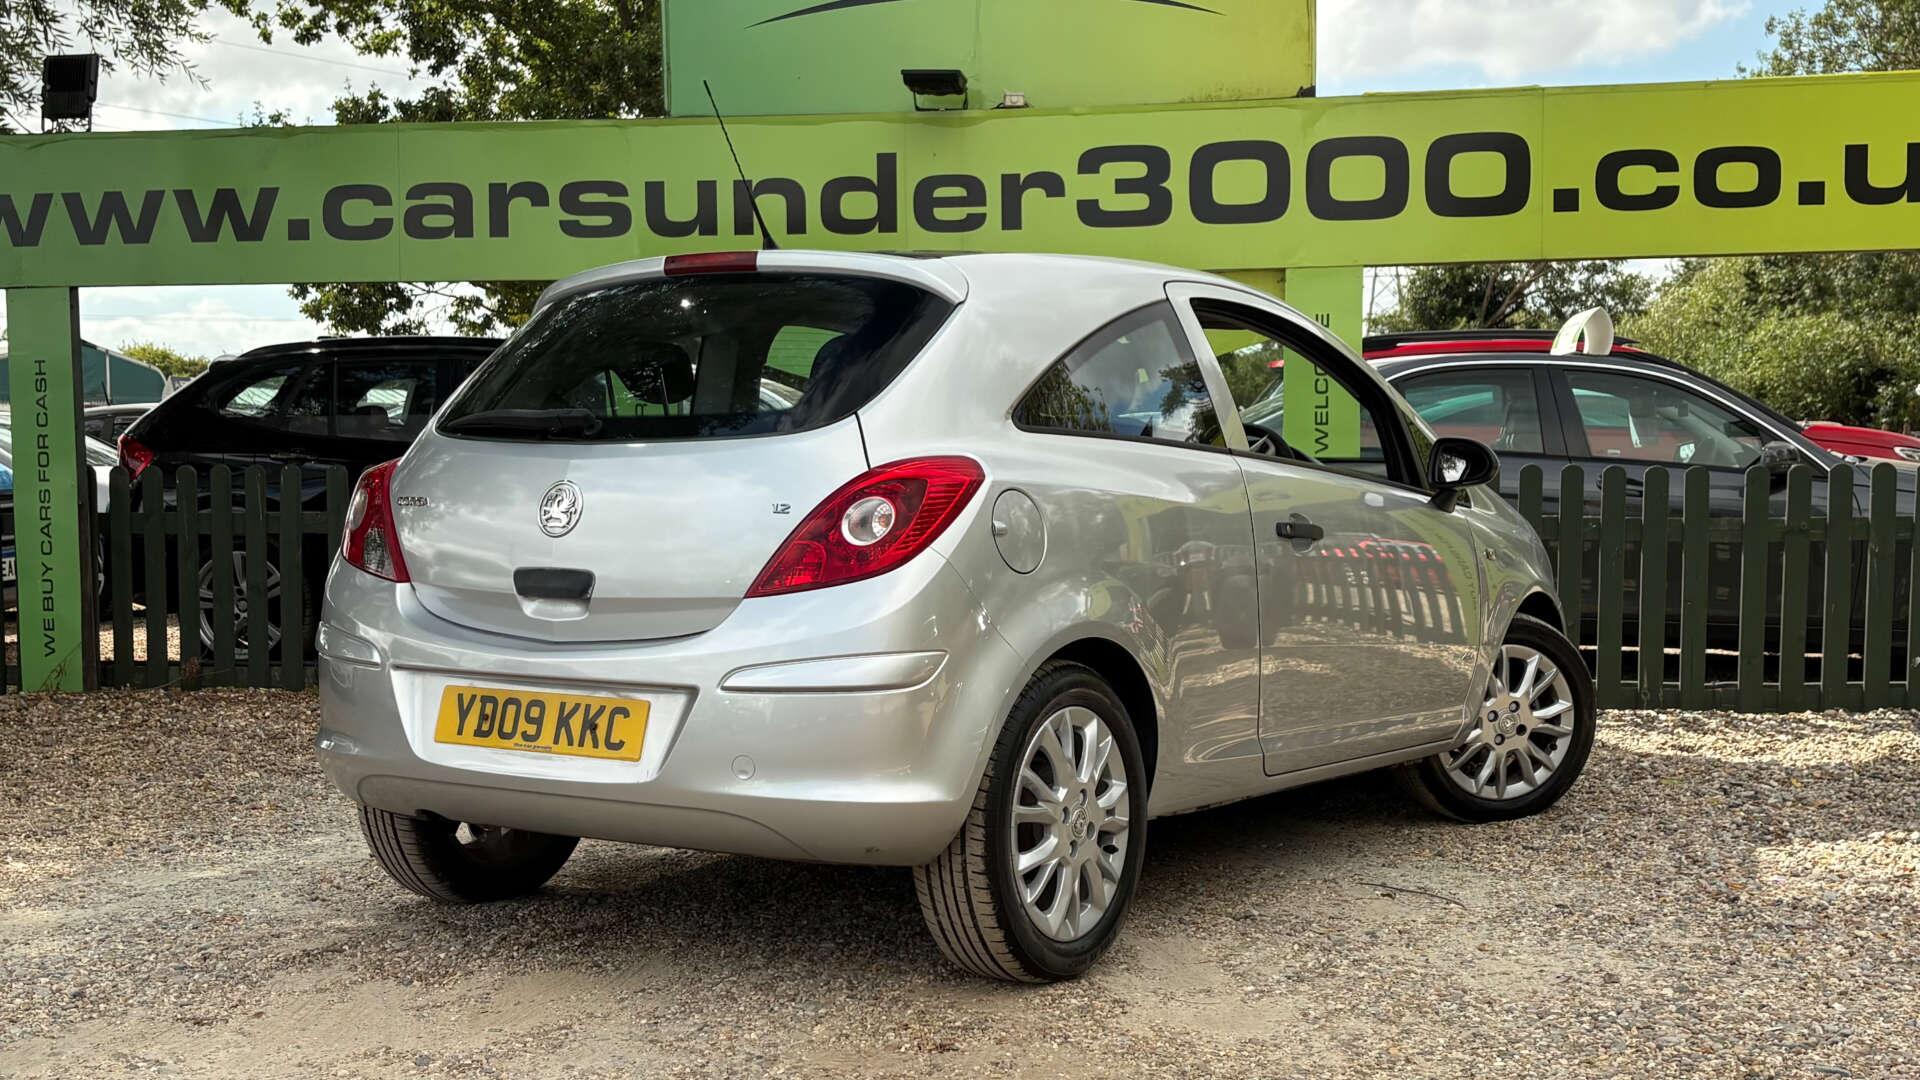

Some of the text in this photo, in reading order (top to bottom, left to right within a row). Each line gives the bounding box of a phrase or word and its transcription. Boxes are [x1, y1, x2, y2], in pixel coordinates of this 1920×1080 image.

[1314, 313, 1330, 454] WELCE
[34, 359, 56, 658] WE BUY CARS FOR CASH
[457, 693, 631, 752] YD09 KKC
